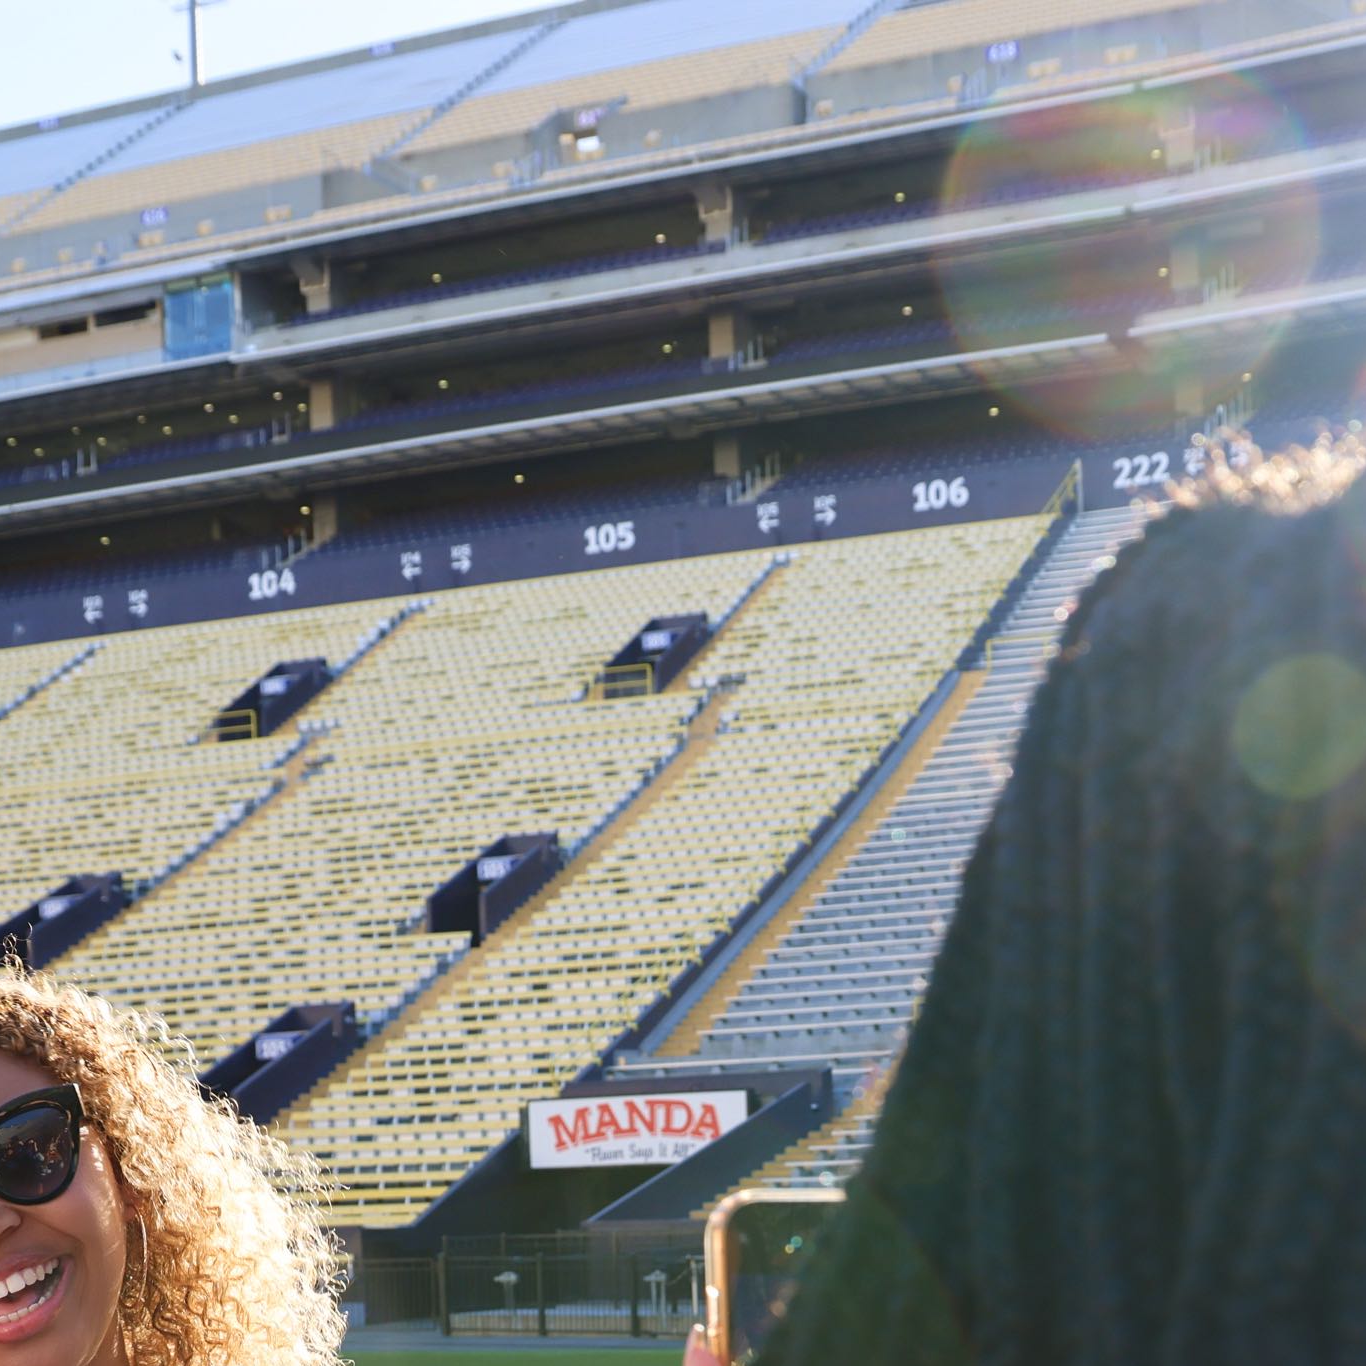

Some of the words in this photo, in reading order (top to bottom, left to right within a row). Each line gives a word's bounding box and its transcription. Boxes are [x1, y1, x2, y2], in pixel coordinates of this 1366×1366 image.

[1113, 452, 1170, 489] 222
[912, 477, 970, 512] 106
[583, 521, 636, 555] 105
[248, 568, 296, 600] 104
[548, 1099, 722, 1151] MANDA
